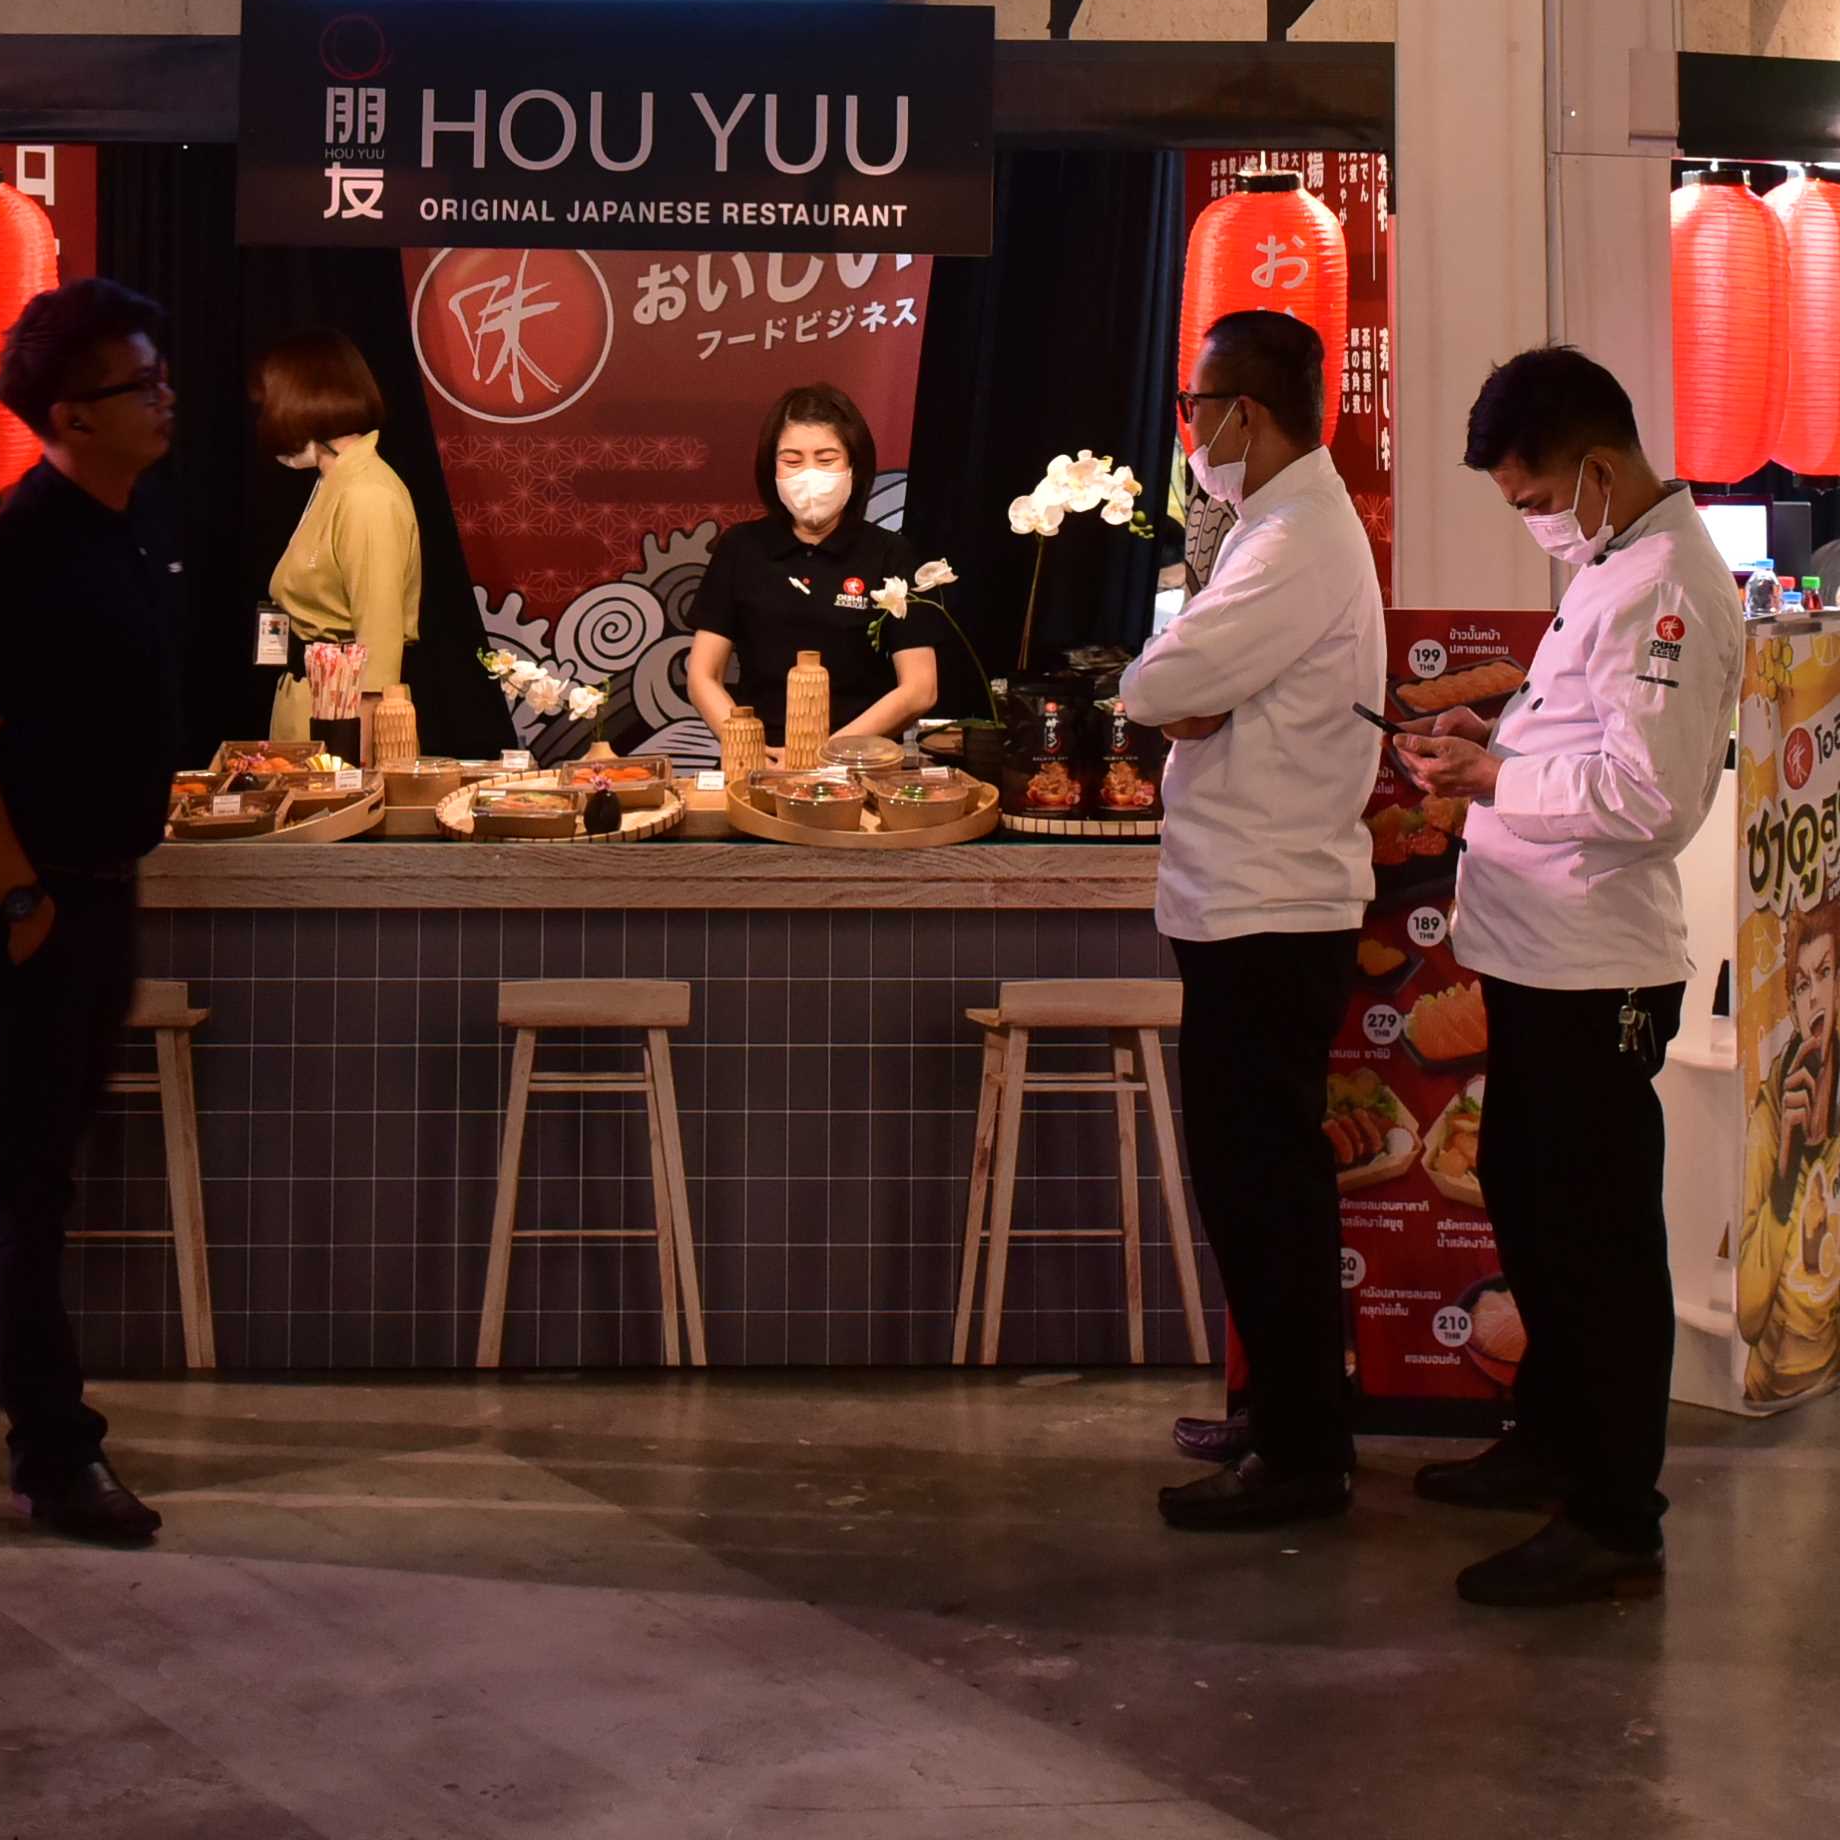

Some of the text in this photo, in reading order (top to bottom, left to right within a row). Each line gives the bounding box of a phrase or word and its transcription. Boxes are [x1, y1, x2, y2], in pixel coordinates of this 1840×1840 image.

[420, 88, 909, 176] HOU YUU
[324, 148, 385, 160] HOU YUU
[419, 197, 908, 227] ORIGINAL JAPANESE RESTAURANT
[695, 297, 918, 360] フードビジネス
[1414, 649, 1441, 662] 199
[1418, 663, 1436, 672] THB
[1413, 917, 1440, 931] 189
[1367, 1013, 1397, 1028] 279
[1438, 1316, 1468, 1330] 210
